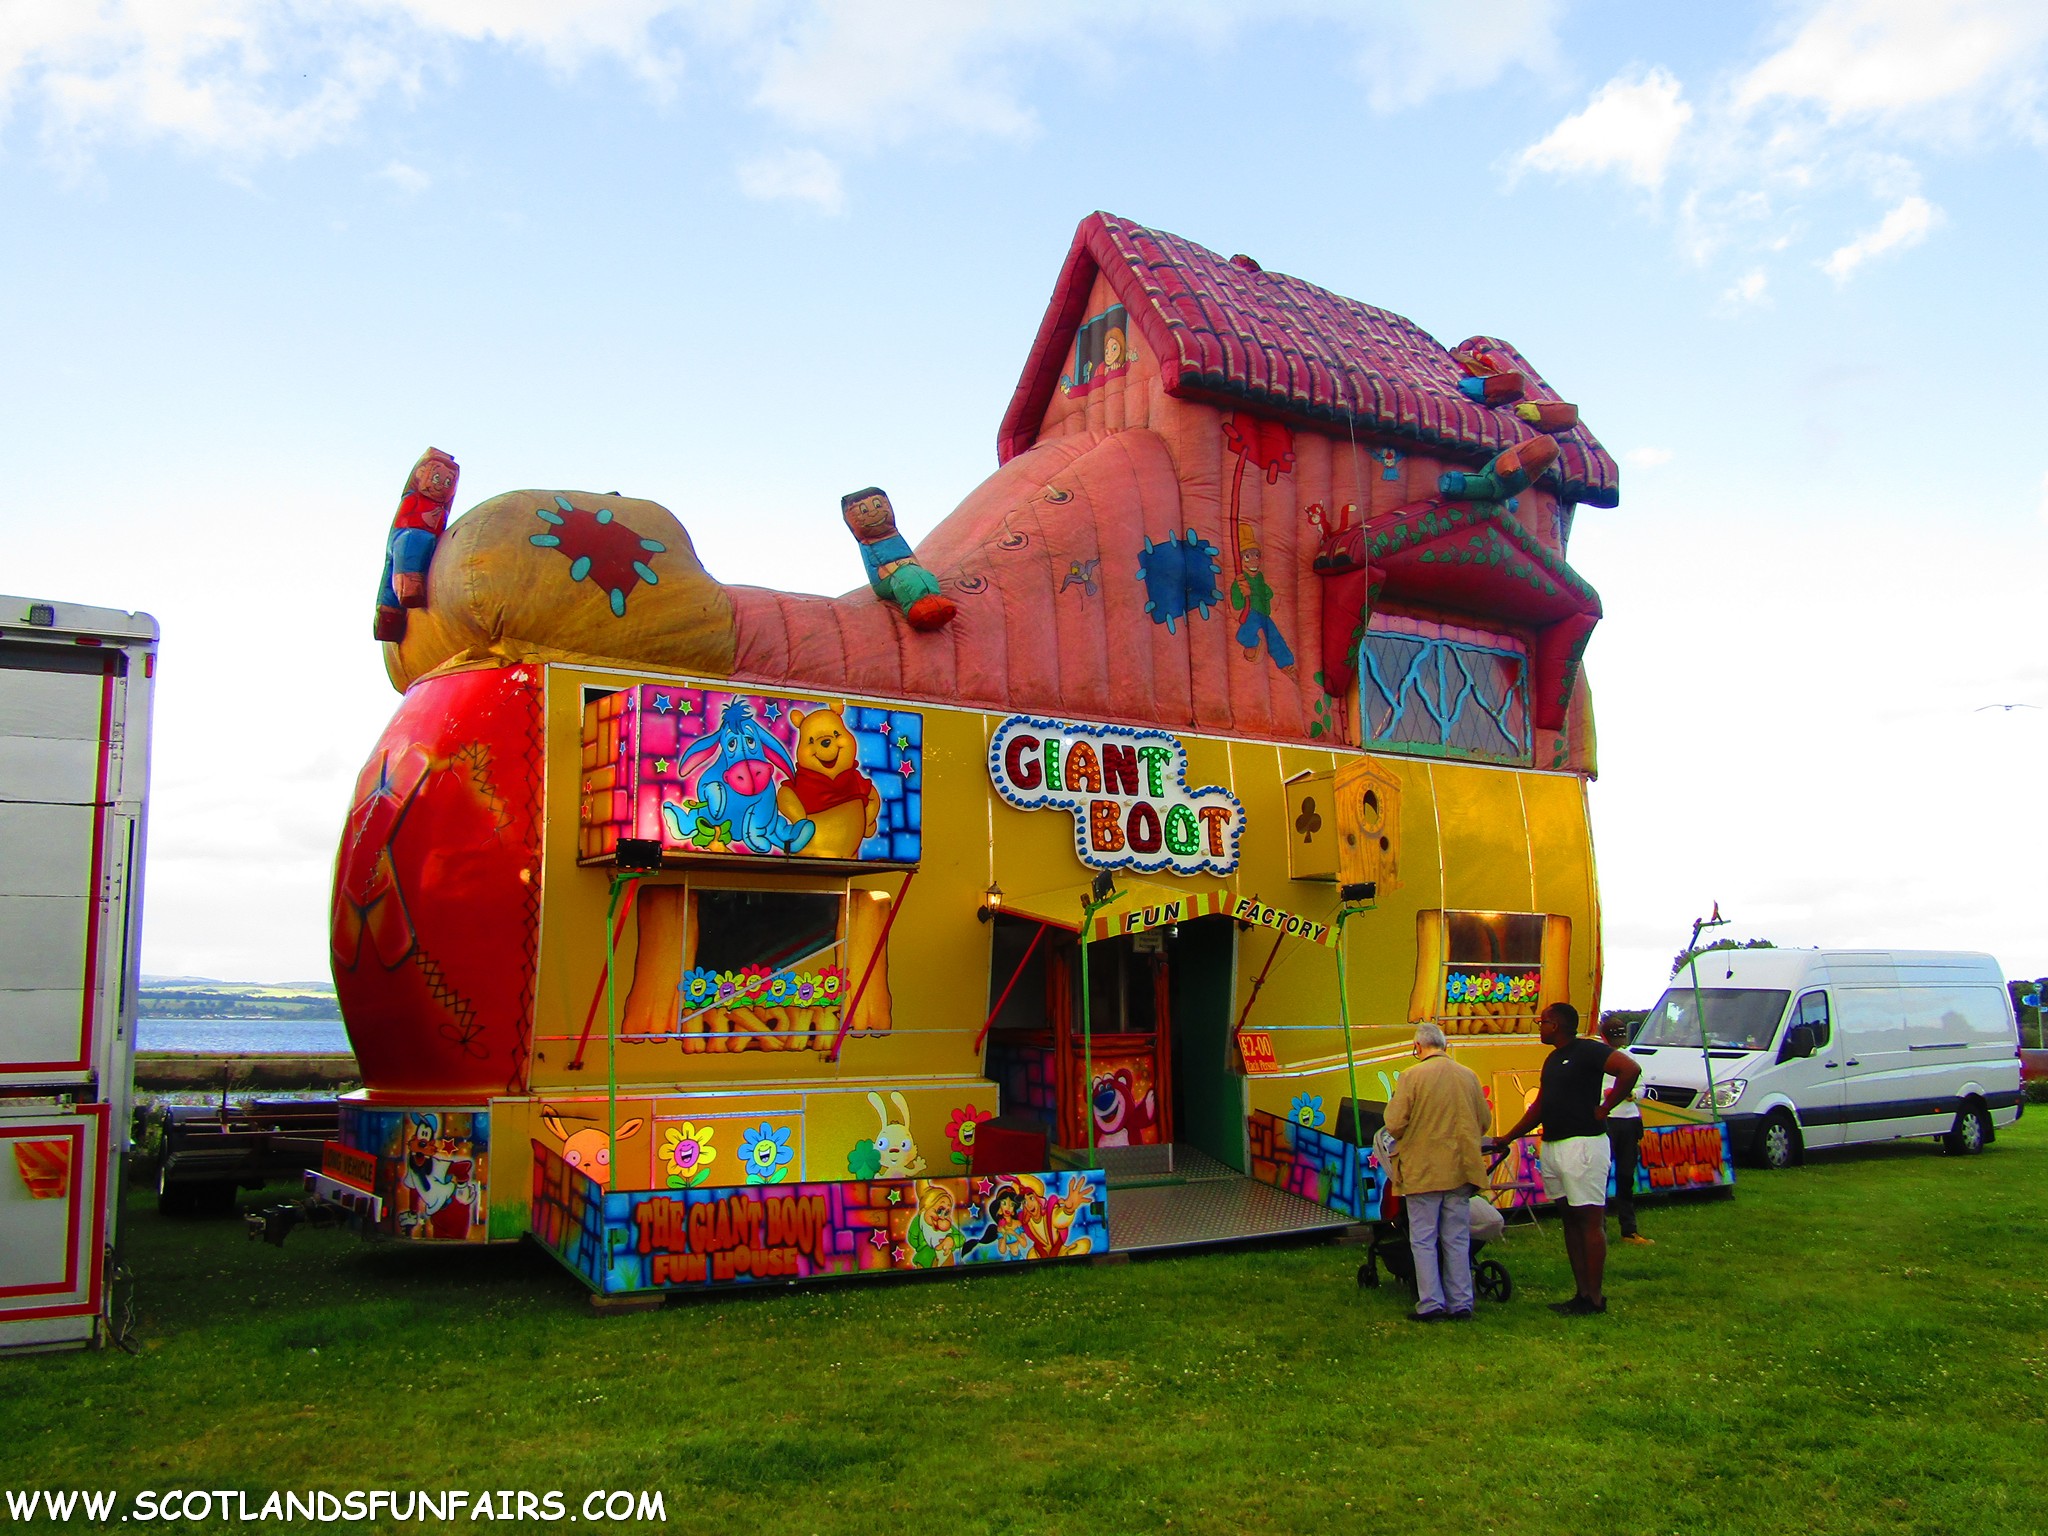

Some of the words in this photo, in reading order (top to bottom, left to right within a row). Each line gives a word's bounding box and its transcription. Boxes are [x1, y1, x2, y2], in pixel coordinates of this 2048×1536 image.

[1005, 734, 1174, 798] GIANT
[1090, 799, 1232, 857] BOOT
[1125, 901, 1181, 932] FUN
[1235, 899, 1326, 942] FACTORY
[343, 1154, 373, 1183] VEHICLE
[1661, 1127, 1696, 1168] GIANT
[1693, 1127, 1724, 1176] BOOT
[1649, 1166, 1675, 1188] FUN
[636, 1196, 687, 1254] THE
[688, 1195, 764, 1254] GIANT
[766, 1195, 827, 1269] BOOT
[653, 1253, 707, 1285] FUN
[713, 1244, 799, 1281] HOUSE
